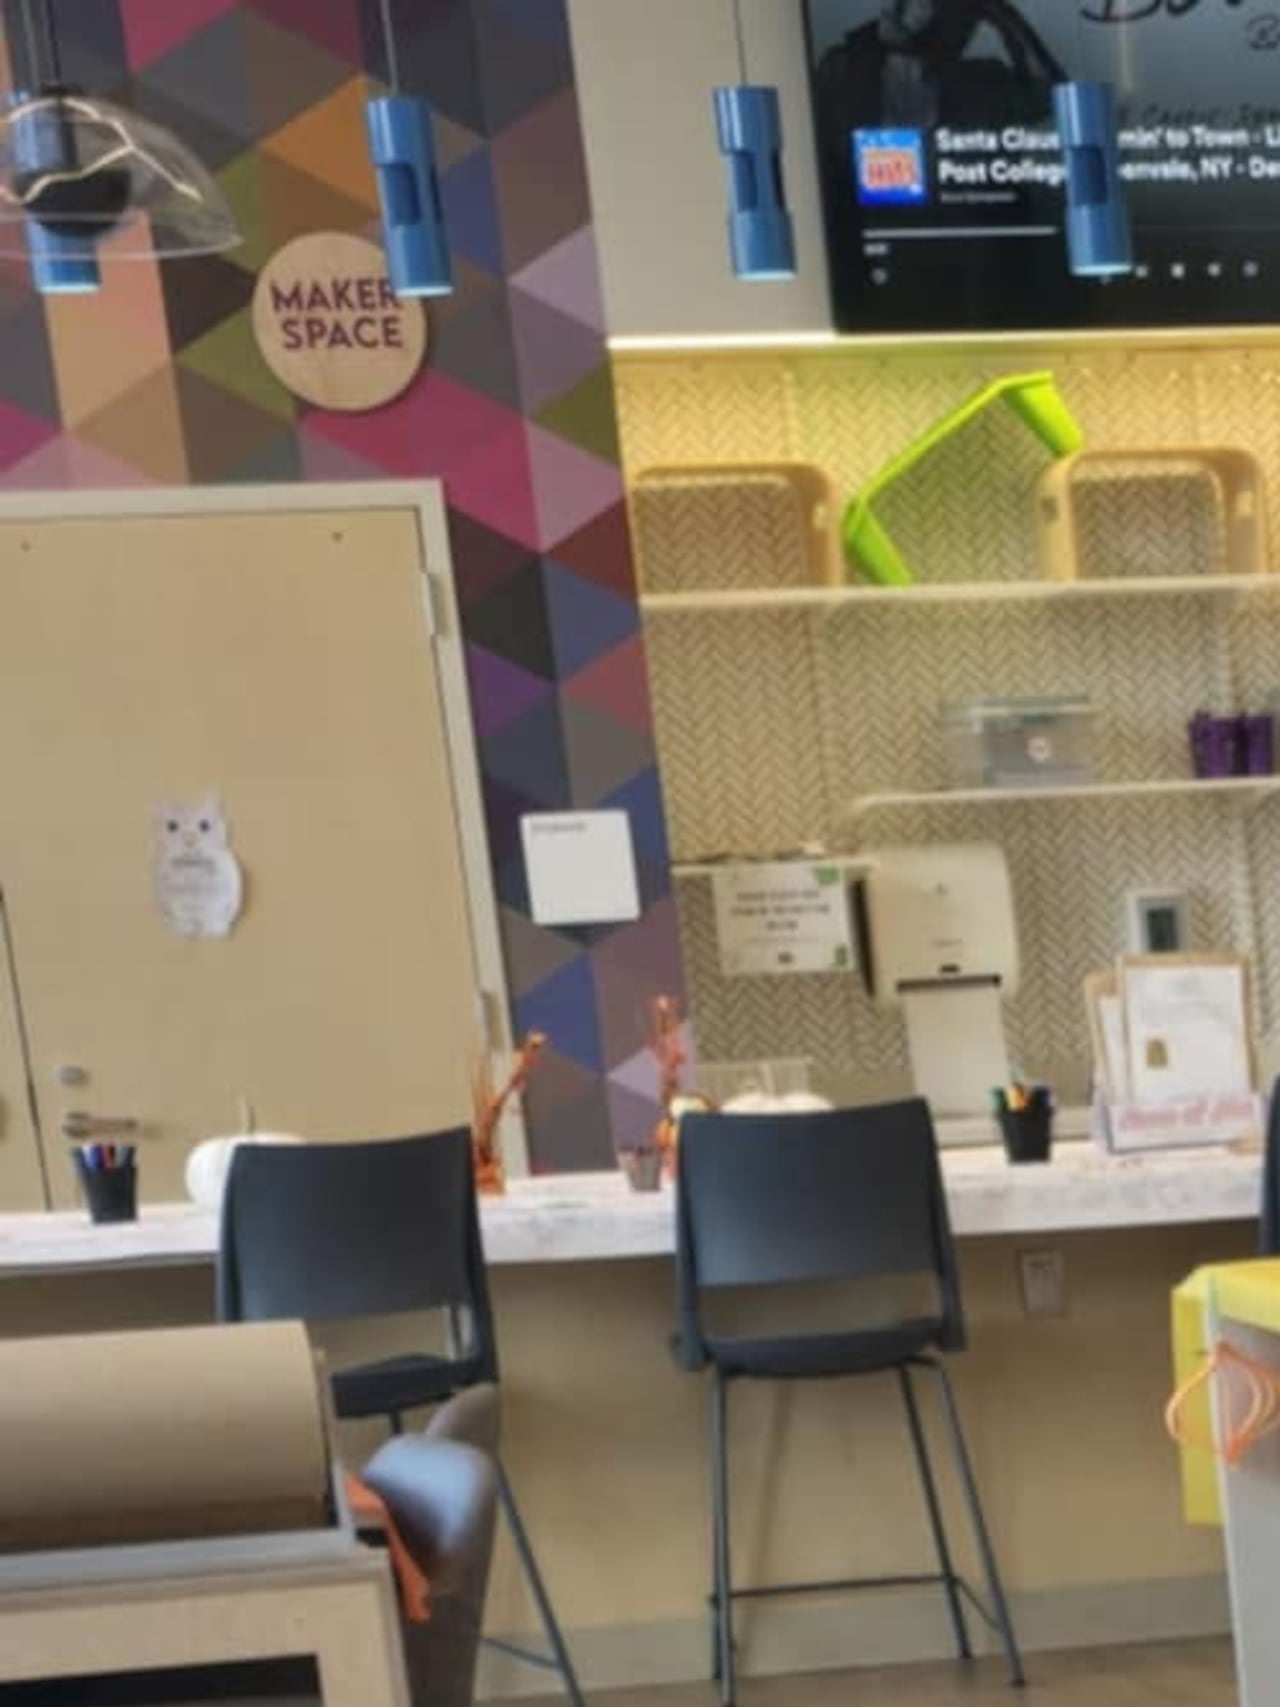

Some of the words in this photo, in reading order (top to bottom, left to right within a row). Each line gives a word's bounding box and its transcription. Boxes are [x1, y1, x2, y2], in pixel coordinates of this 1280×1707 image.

[935, 127, 997, 150] Santa
[1166, 126, 1189, 148] to
[1191, 124, 1250, 148] Town
[937, 159, 988, 183] Post
[1201, 154, 1234, 178] NY
[270, 278, 404, 312] MAKER
[282, 316, 404, 350] SPACE
